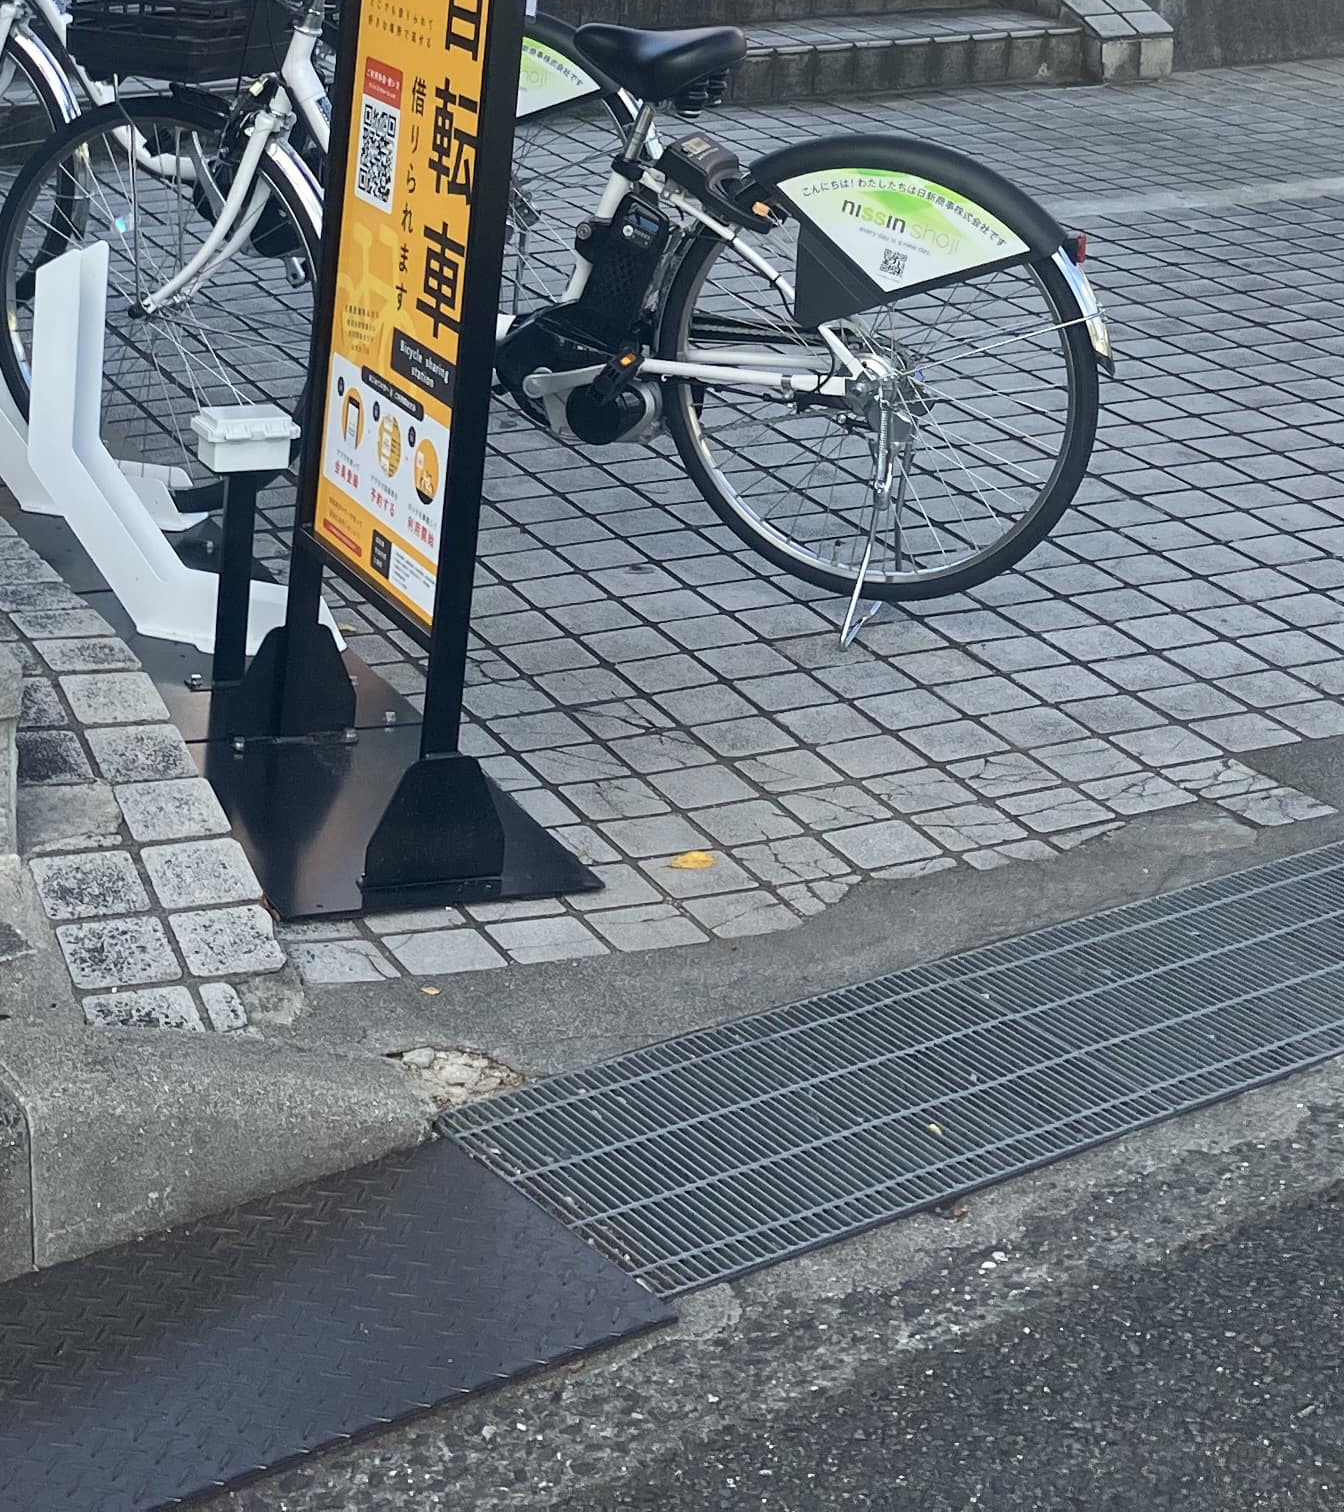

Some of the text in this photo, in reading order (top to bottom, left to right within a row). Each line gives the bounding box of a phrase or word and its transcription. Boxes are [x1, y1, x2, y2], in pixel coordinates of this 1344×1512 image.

[395, 75, 427, 312] 借りられます
[842, 199, 906, 233] nissin
[400, 339, 449, 384] Bicycle sharing
[411, 366, 434, 388] station
